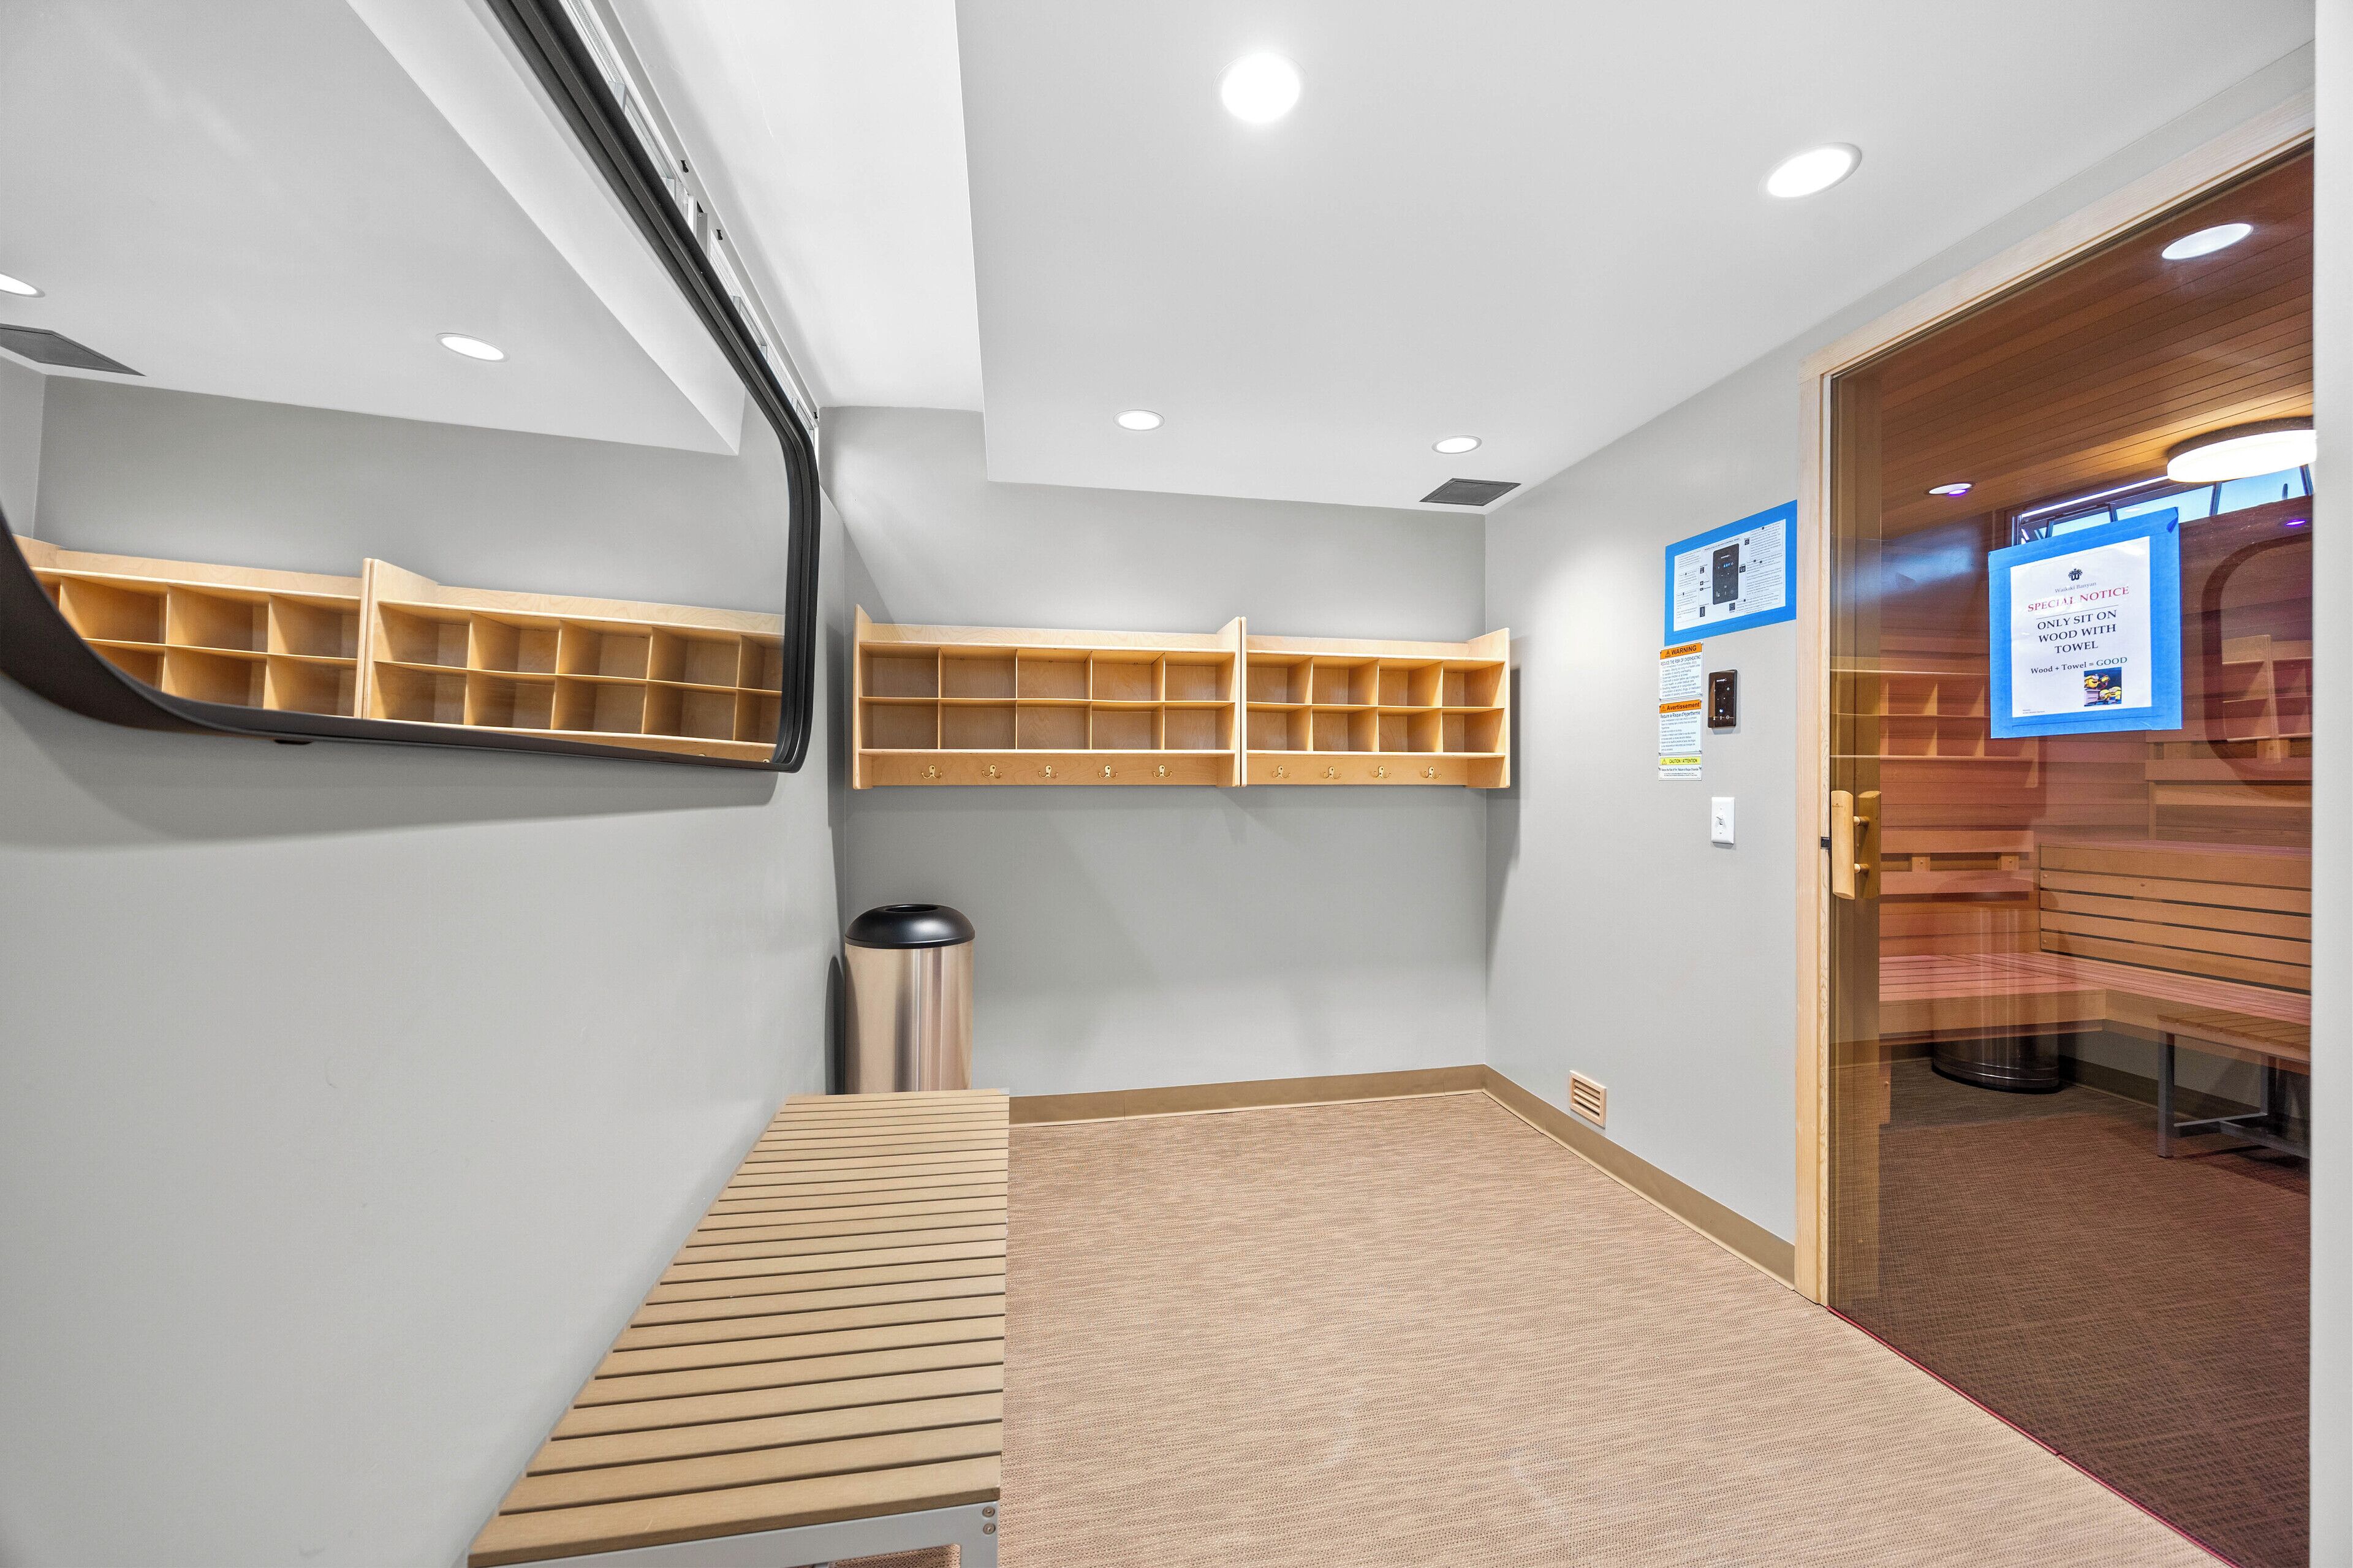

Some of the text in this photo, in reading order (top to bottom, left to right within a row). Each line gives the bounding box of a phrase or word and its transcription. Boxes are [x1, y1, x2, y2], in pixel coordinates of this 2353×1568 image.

[2028, 586, 2129, 612] SPECIAL NOTICE
[2037, 610, 2117, 630] ONLY SIT ON
[2039, 624, 2117, 642] WOOD WITH
[1672, 645, 1697, 655] WARNING
[2055, 641, 2098, 653] TOWEL
[2061, 662, 2086, 670] Towel
[2096, 657, 2128, 666] GOOD
